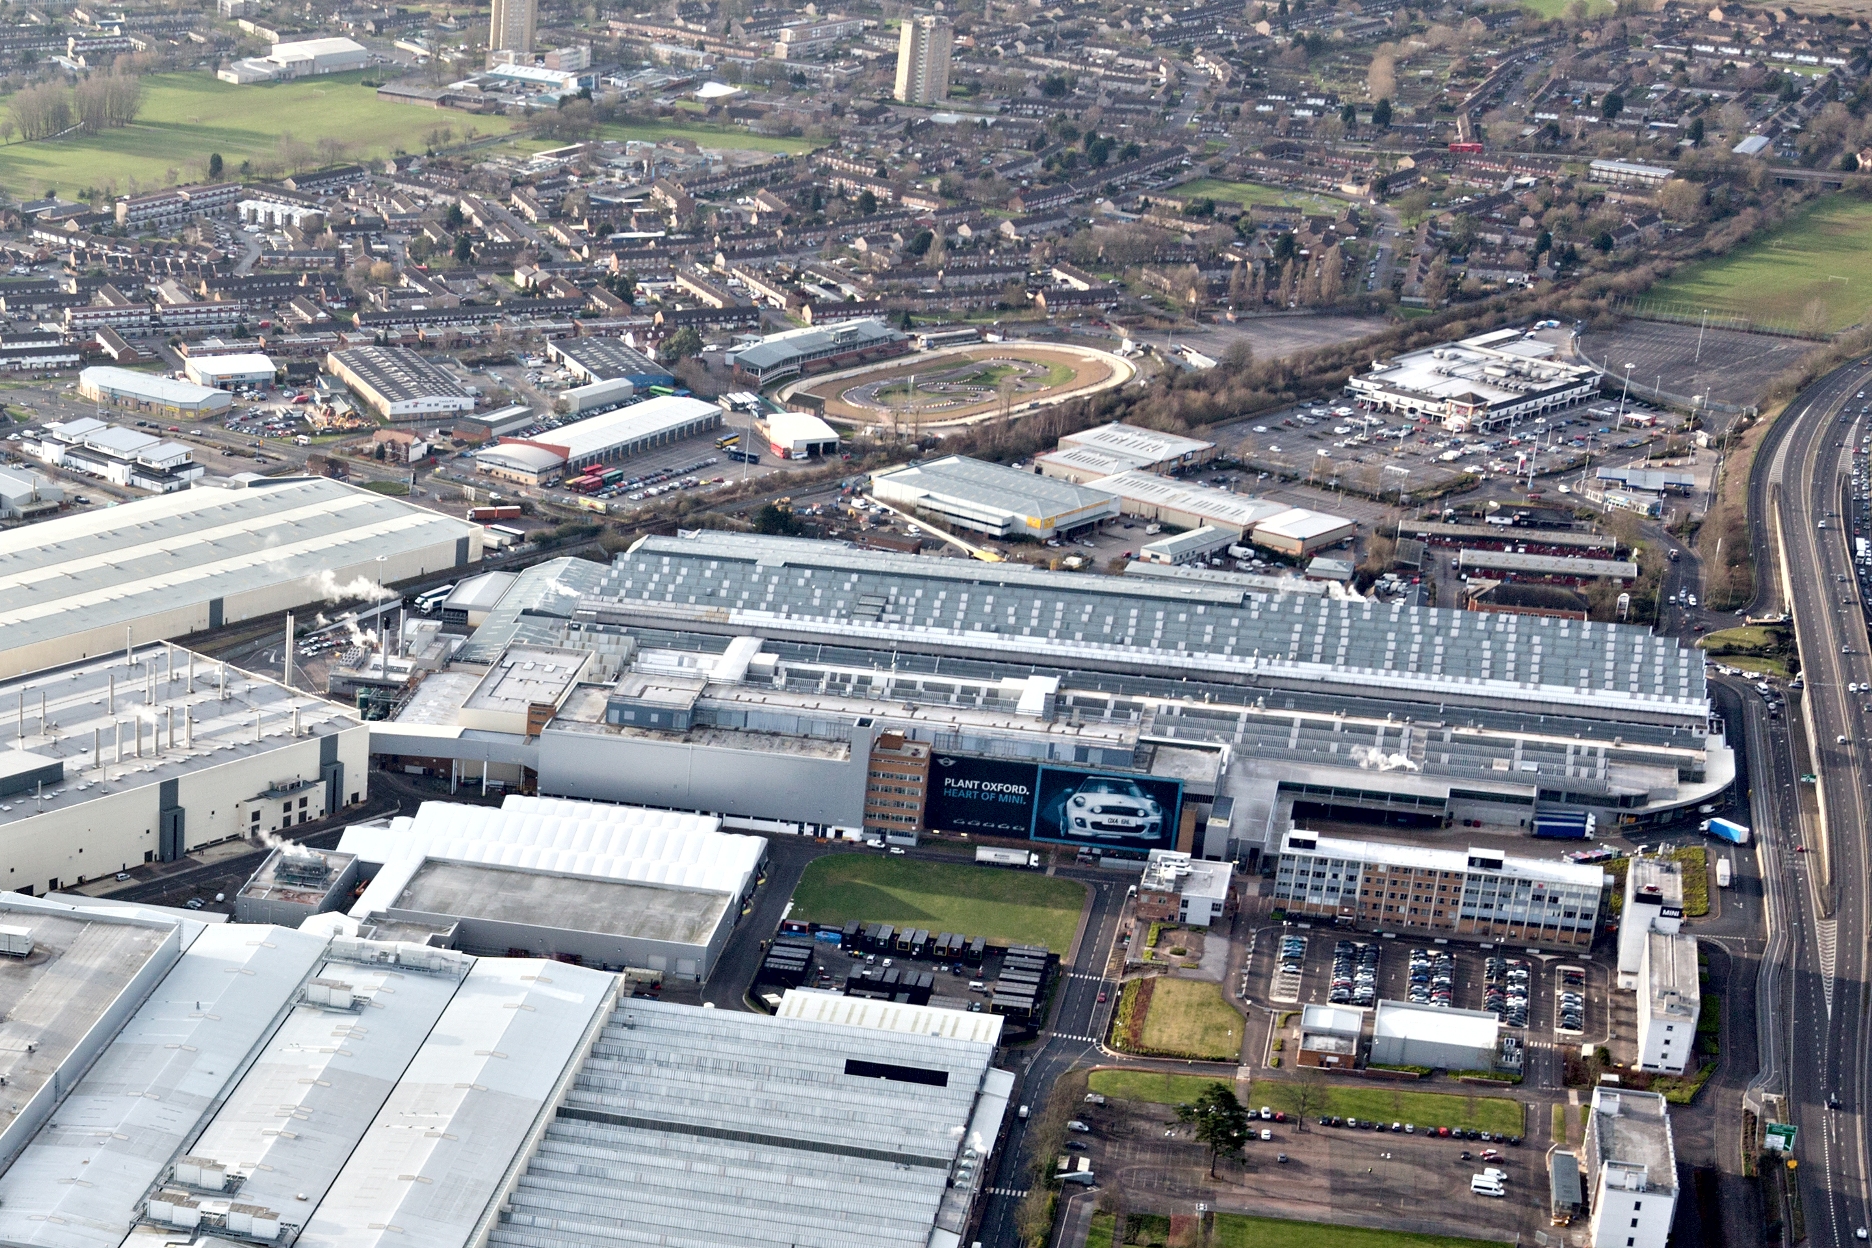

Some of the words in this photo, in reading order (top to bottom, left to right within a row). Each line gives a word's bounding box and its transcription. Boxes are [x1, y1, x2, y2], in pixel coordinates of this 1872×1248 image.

[944, 777, 980, 790] PLANT
[981, 781, 1030, 796] OXFORD.
[943, 787, 980, 800] HEART
[980, 792, 996, 801] OF
[998, 793, 1027, 806] MINI.
[1662, 909, 1679, 917] MINI
